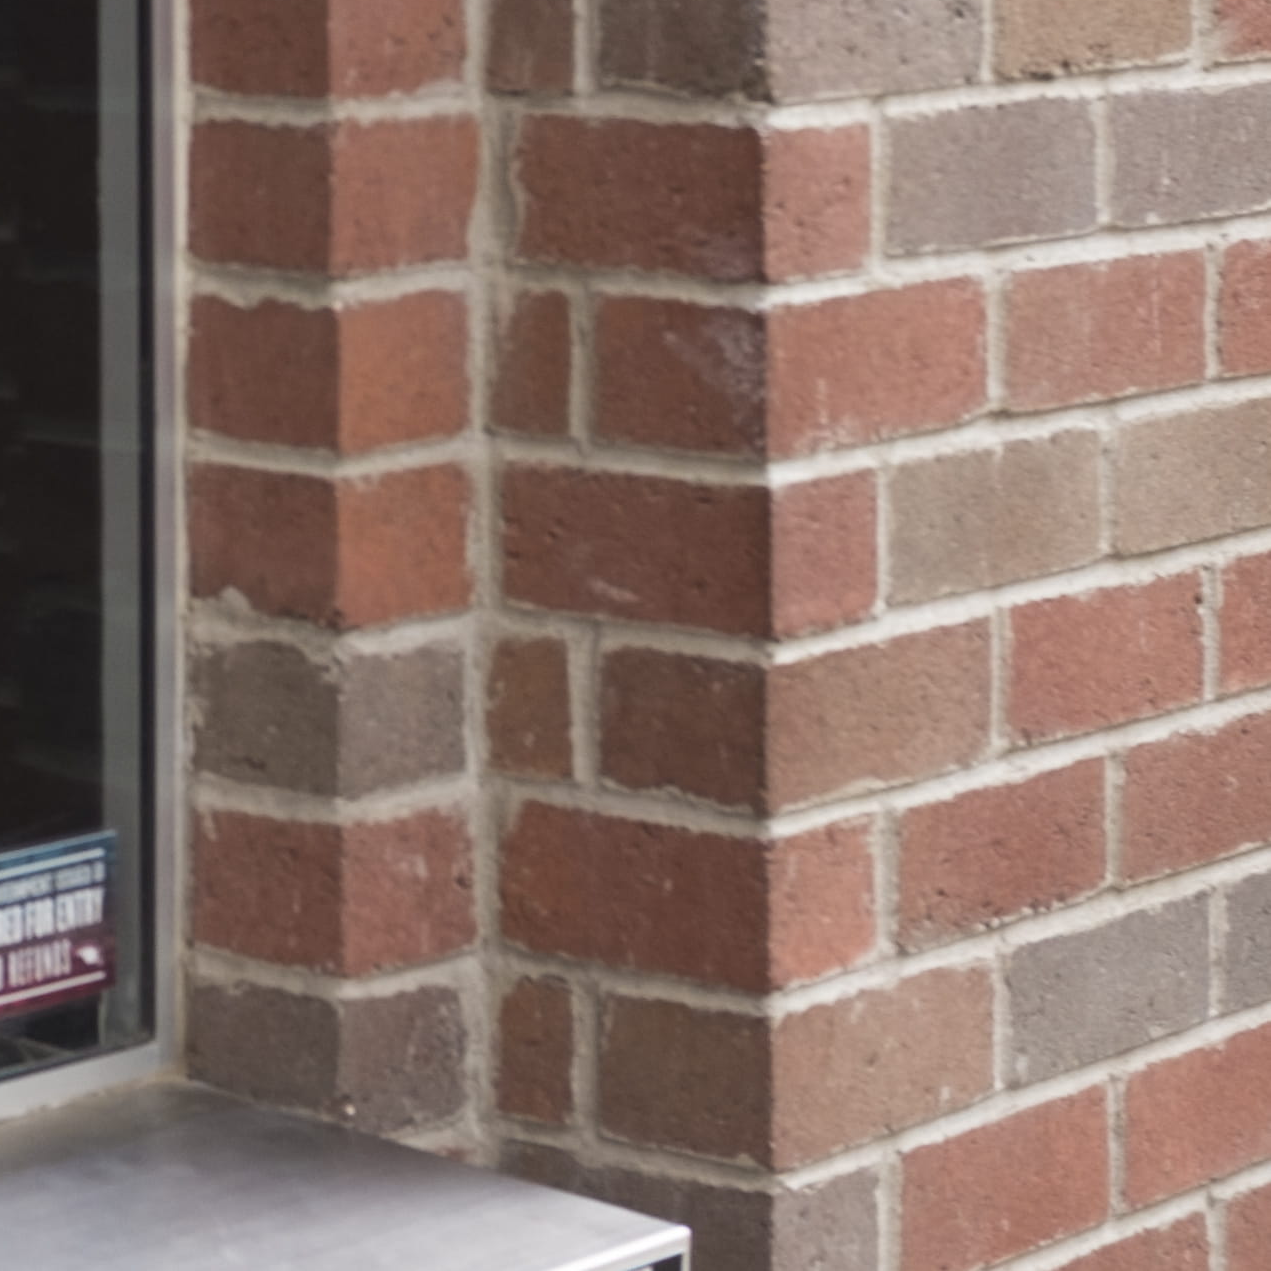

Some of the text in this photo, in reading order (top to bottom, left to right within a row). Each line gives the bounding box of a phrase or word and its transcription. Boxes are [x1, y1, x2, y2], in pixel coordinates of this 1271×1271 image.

[25, 897, 55, 940] FOR
[56, 886, 105, 933] ENTRY
[7, 937, 73, 989] REFUNDS
